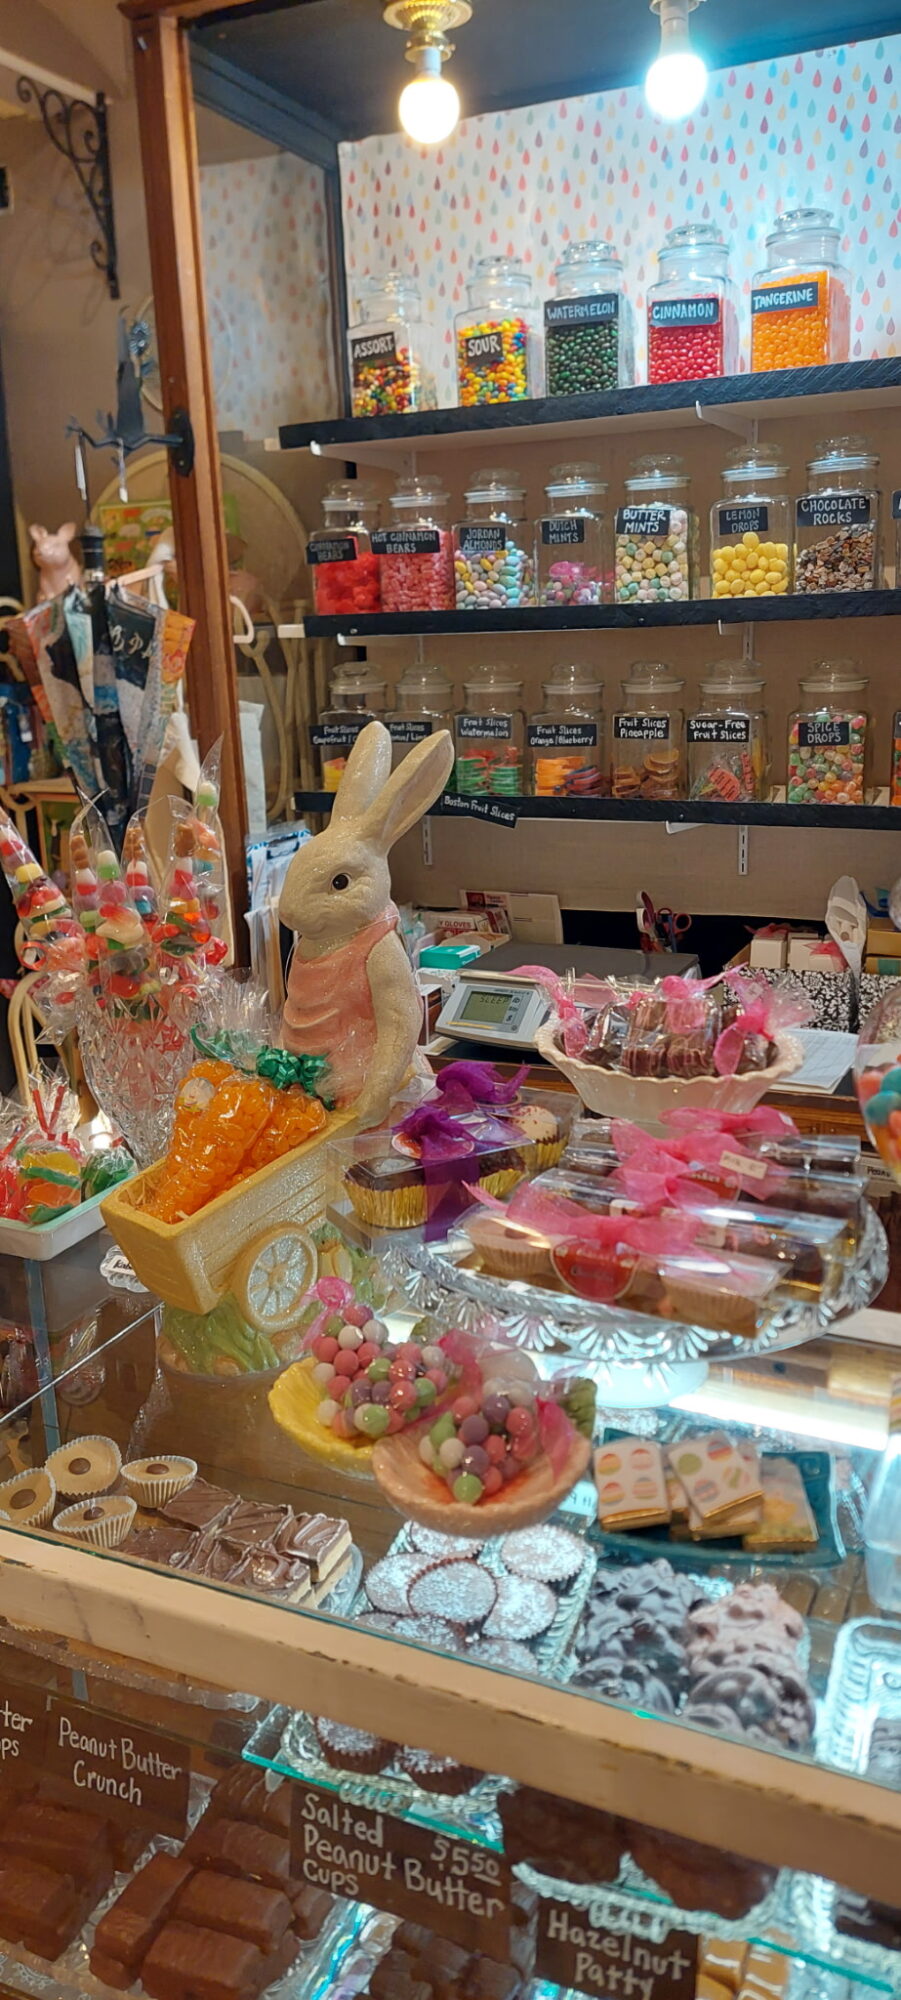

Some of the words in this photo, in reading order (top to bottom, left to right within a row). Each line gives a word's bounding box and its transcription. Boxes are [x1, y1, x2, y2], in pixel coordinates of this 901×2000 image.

[753, 287, 813, 310] TANGERINE
[546, 301, 616, 320] WATERMELON
[652, 302, 715, 320] CINNAMON
[467, 333, 502, 357] SOUR
[800, 498, 866, 513] CHOCOLATE
[622, 509, 667, 521] BUTTER
[726, 508, 760, 521] LEMON
[813, 511, 853, 526] ROCKS
[548, 519, 578, 532] DUTCH
[624, 521, 660, 534] MINTS
[731, 520, 760, 533] DROPS
[371, 532, 387, 543] HOT
[390, 531, 436, 542] CINNAMON
[466, 528, 501, 540] JORDAN
[548, 532, 580, 544] MINTS
[385, 542, 417, 554] BEARS
[463, 540, 503, 551] ALMONDS
[463, 718, 482, 728] Fruit
[485, 717, 508, 728] Slices
[618, 717, 639, 728] Fruit
[641, 718, 667, 728] Slices
[807, 722, 841, 733] SPICE
[460, 727, 509, 738] Watermelon
[536, 726, 556, 736] Fruit
[559, 725, 582, 735] Slices
[620, 728, 665, 739] Pineapple
[693, 729, 718, 740] Fruit
[719, 730, 746, 740] Slices
[807, 732, 842, 744] DROPS
[444, 795, 470, 809] Boston
[470, 800, 489, 814] Fruit
[489, 805, 516, 821] Slices
[444, 920, 472, 928] GLOVES
[0, 1700, 33, 1732] ter
[0, 1738, 20, 1760] ps
[58, 1716, 118, 1760] Peanut
[121, 1737, 183, 1780] Butter
[73, 1760, 142, 1806] Crunch
[301, 1792, 384, 1848] Salted
[302, 1858, 360, 1896] Cups
[303, 1823, 397, 1880] Peanut
[403, 1857, 506, 1919] Butter
[547, 1909, 691, 1980] Hazelnut
[574, 1952, 655, 2000] Patty
